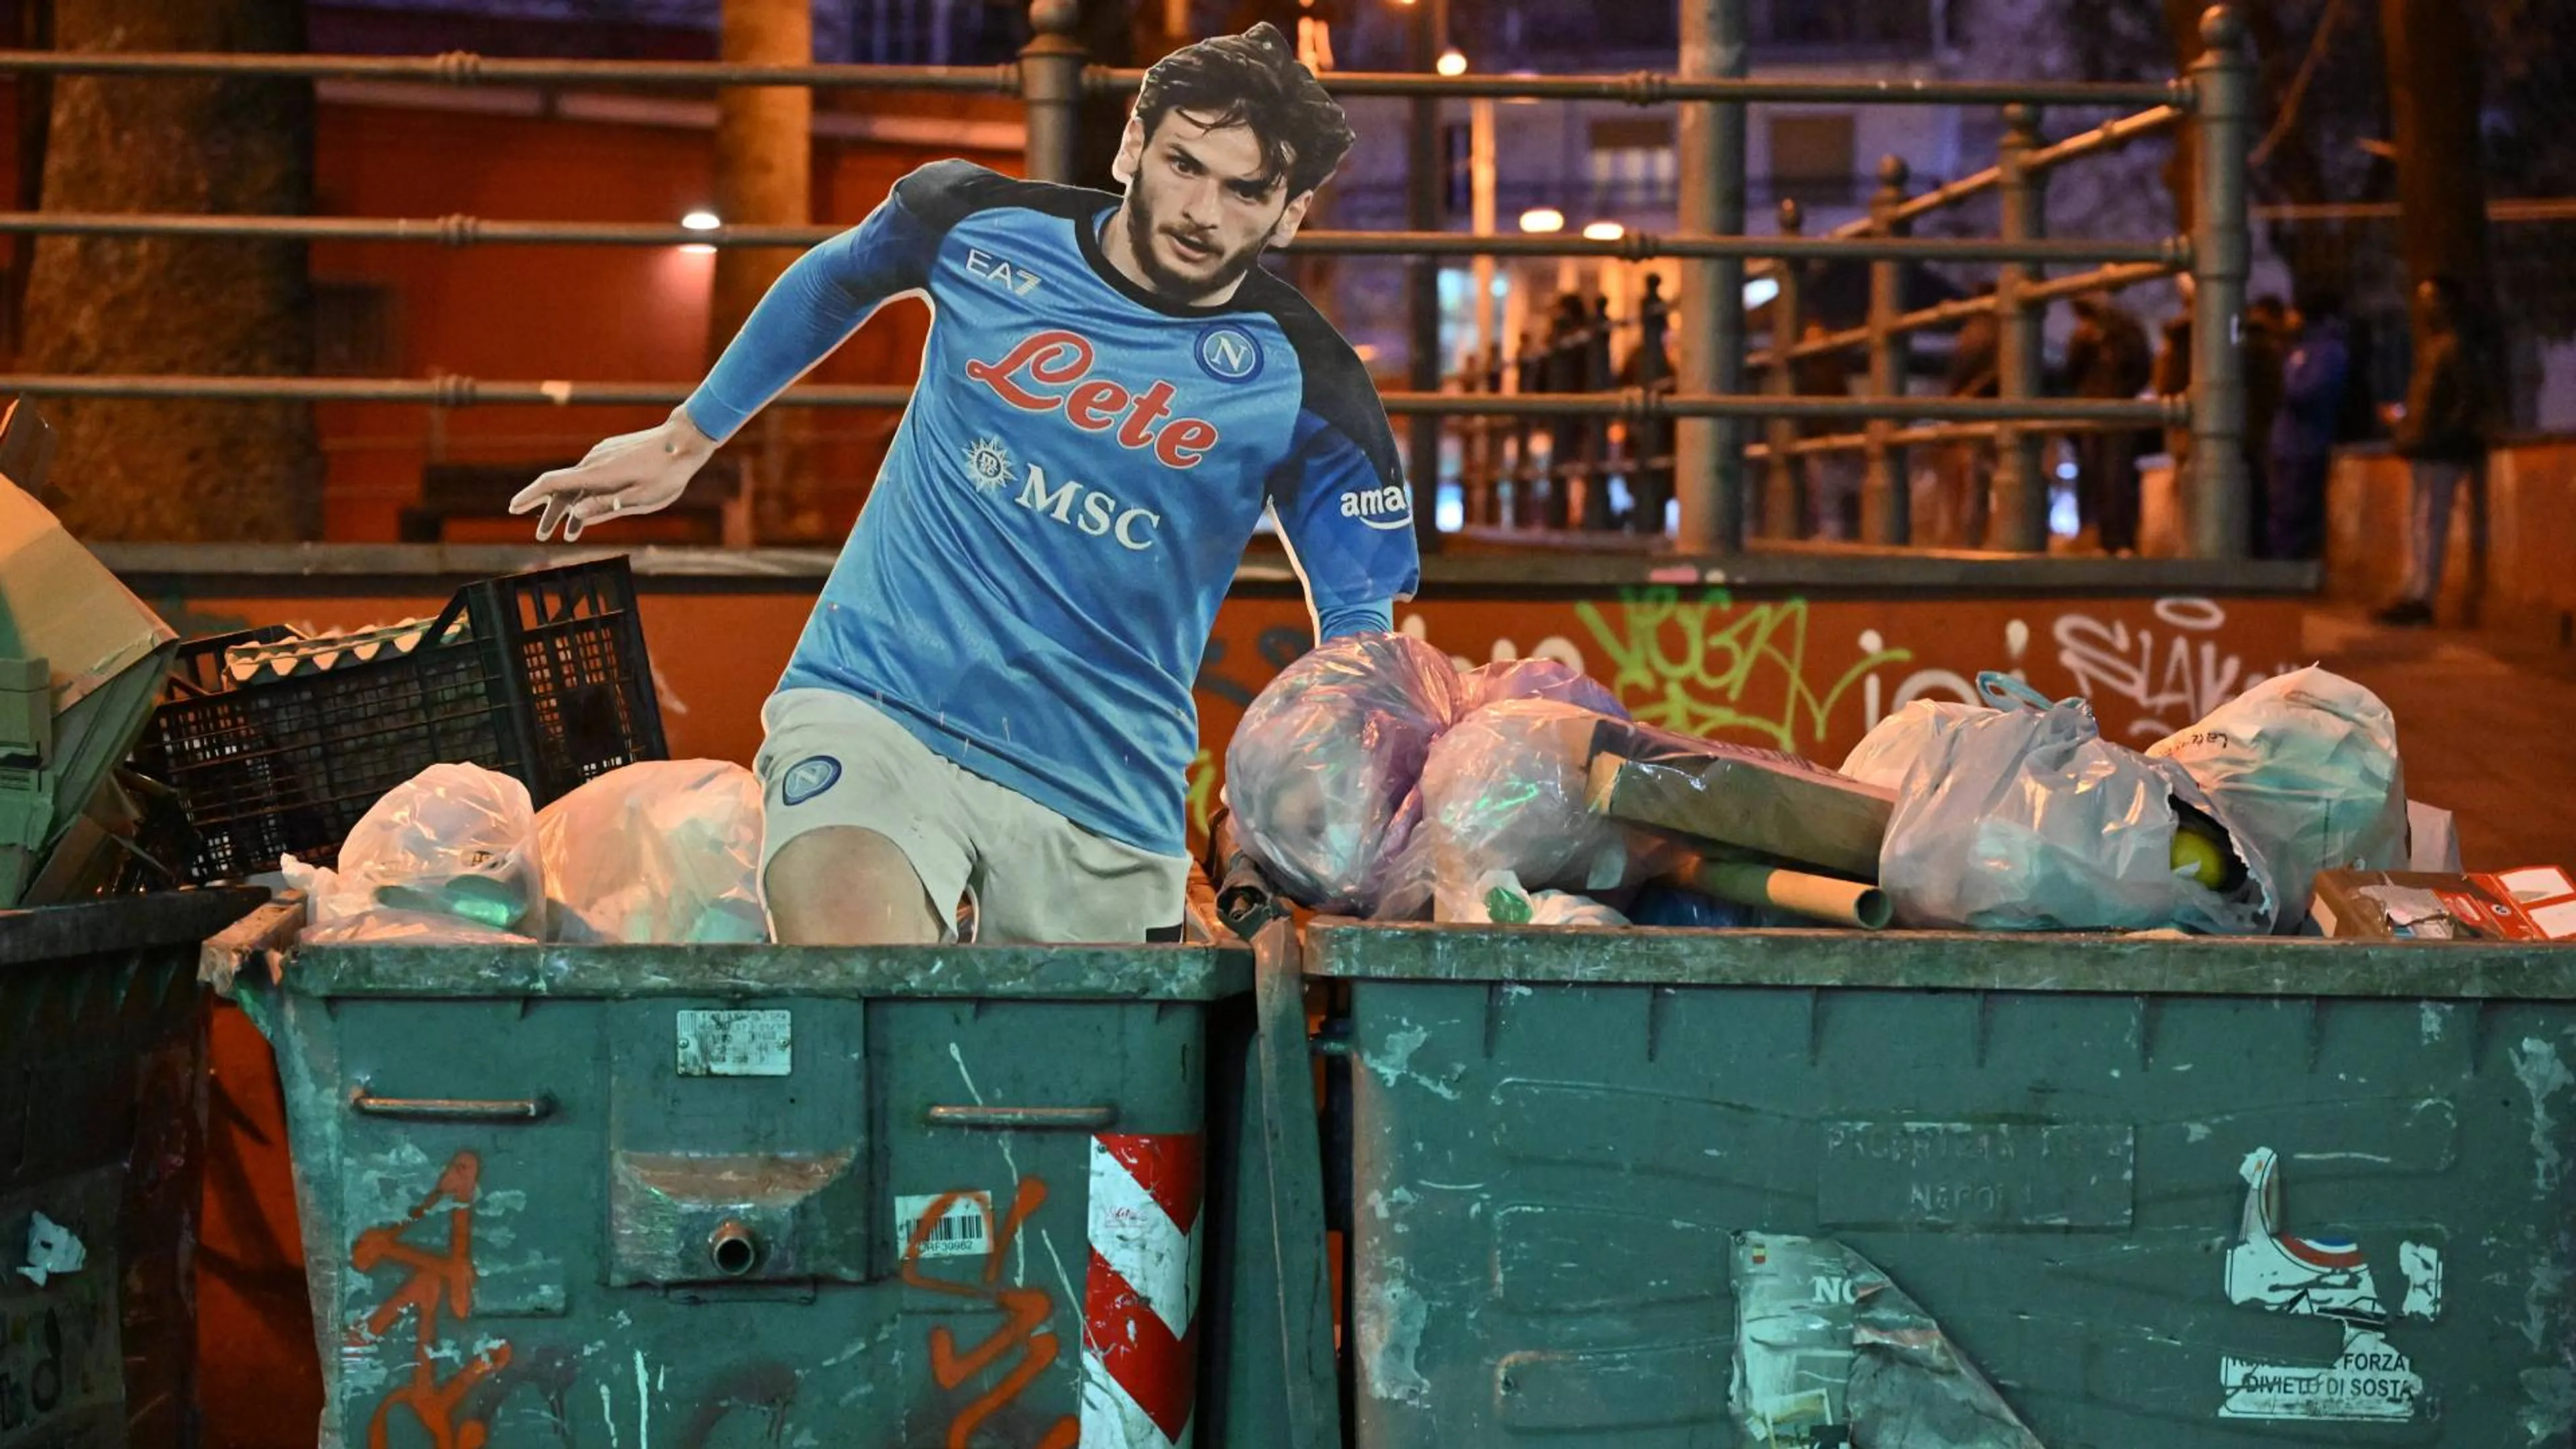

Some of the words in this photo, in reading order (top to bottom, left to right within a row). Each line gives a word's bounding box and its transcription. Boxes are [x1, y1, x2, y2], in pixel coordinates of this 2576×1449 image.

[966, 248, 1042, 296] EA7
[1210, 337, 1248, 371] N
[965, 329, 1220, 468] Lete
[1015, 462, 1160, 550] MSC
[2343, 1352, 2406, 1371] FORZA
[2245, 1375, 2320, 1394] DIVIETO
[2327, 1378, 2344, 1396] DI
[2350, 1379, 2414, 1401] SOSTA
